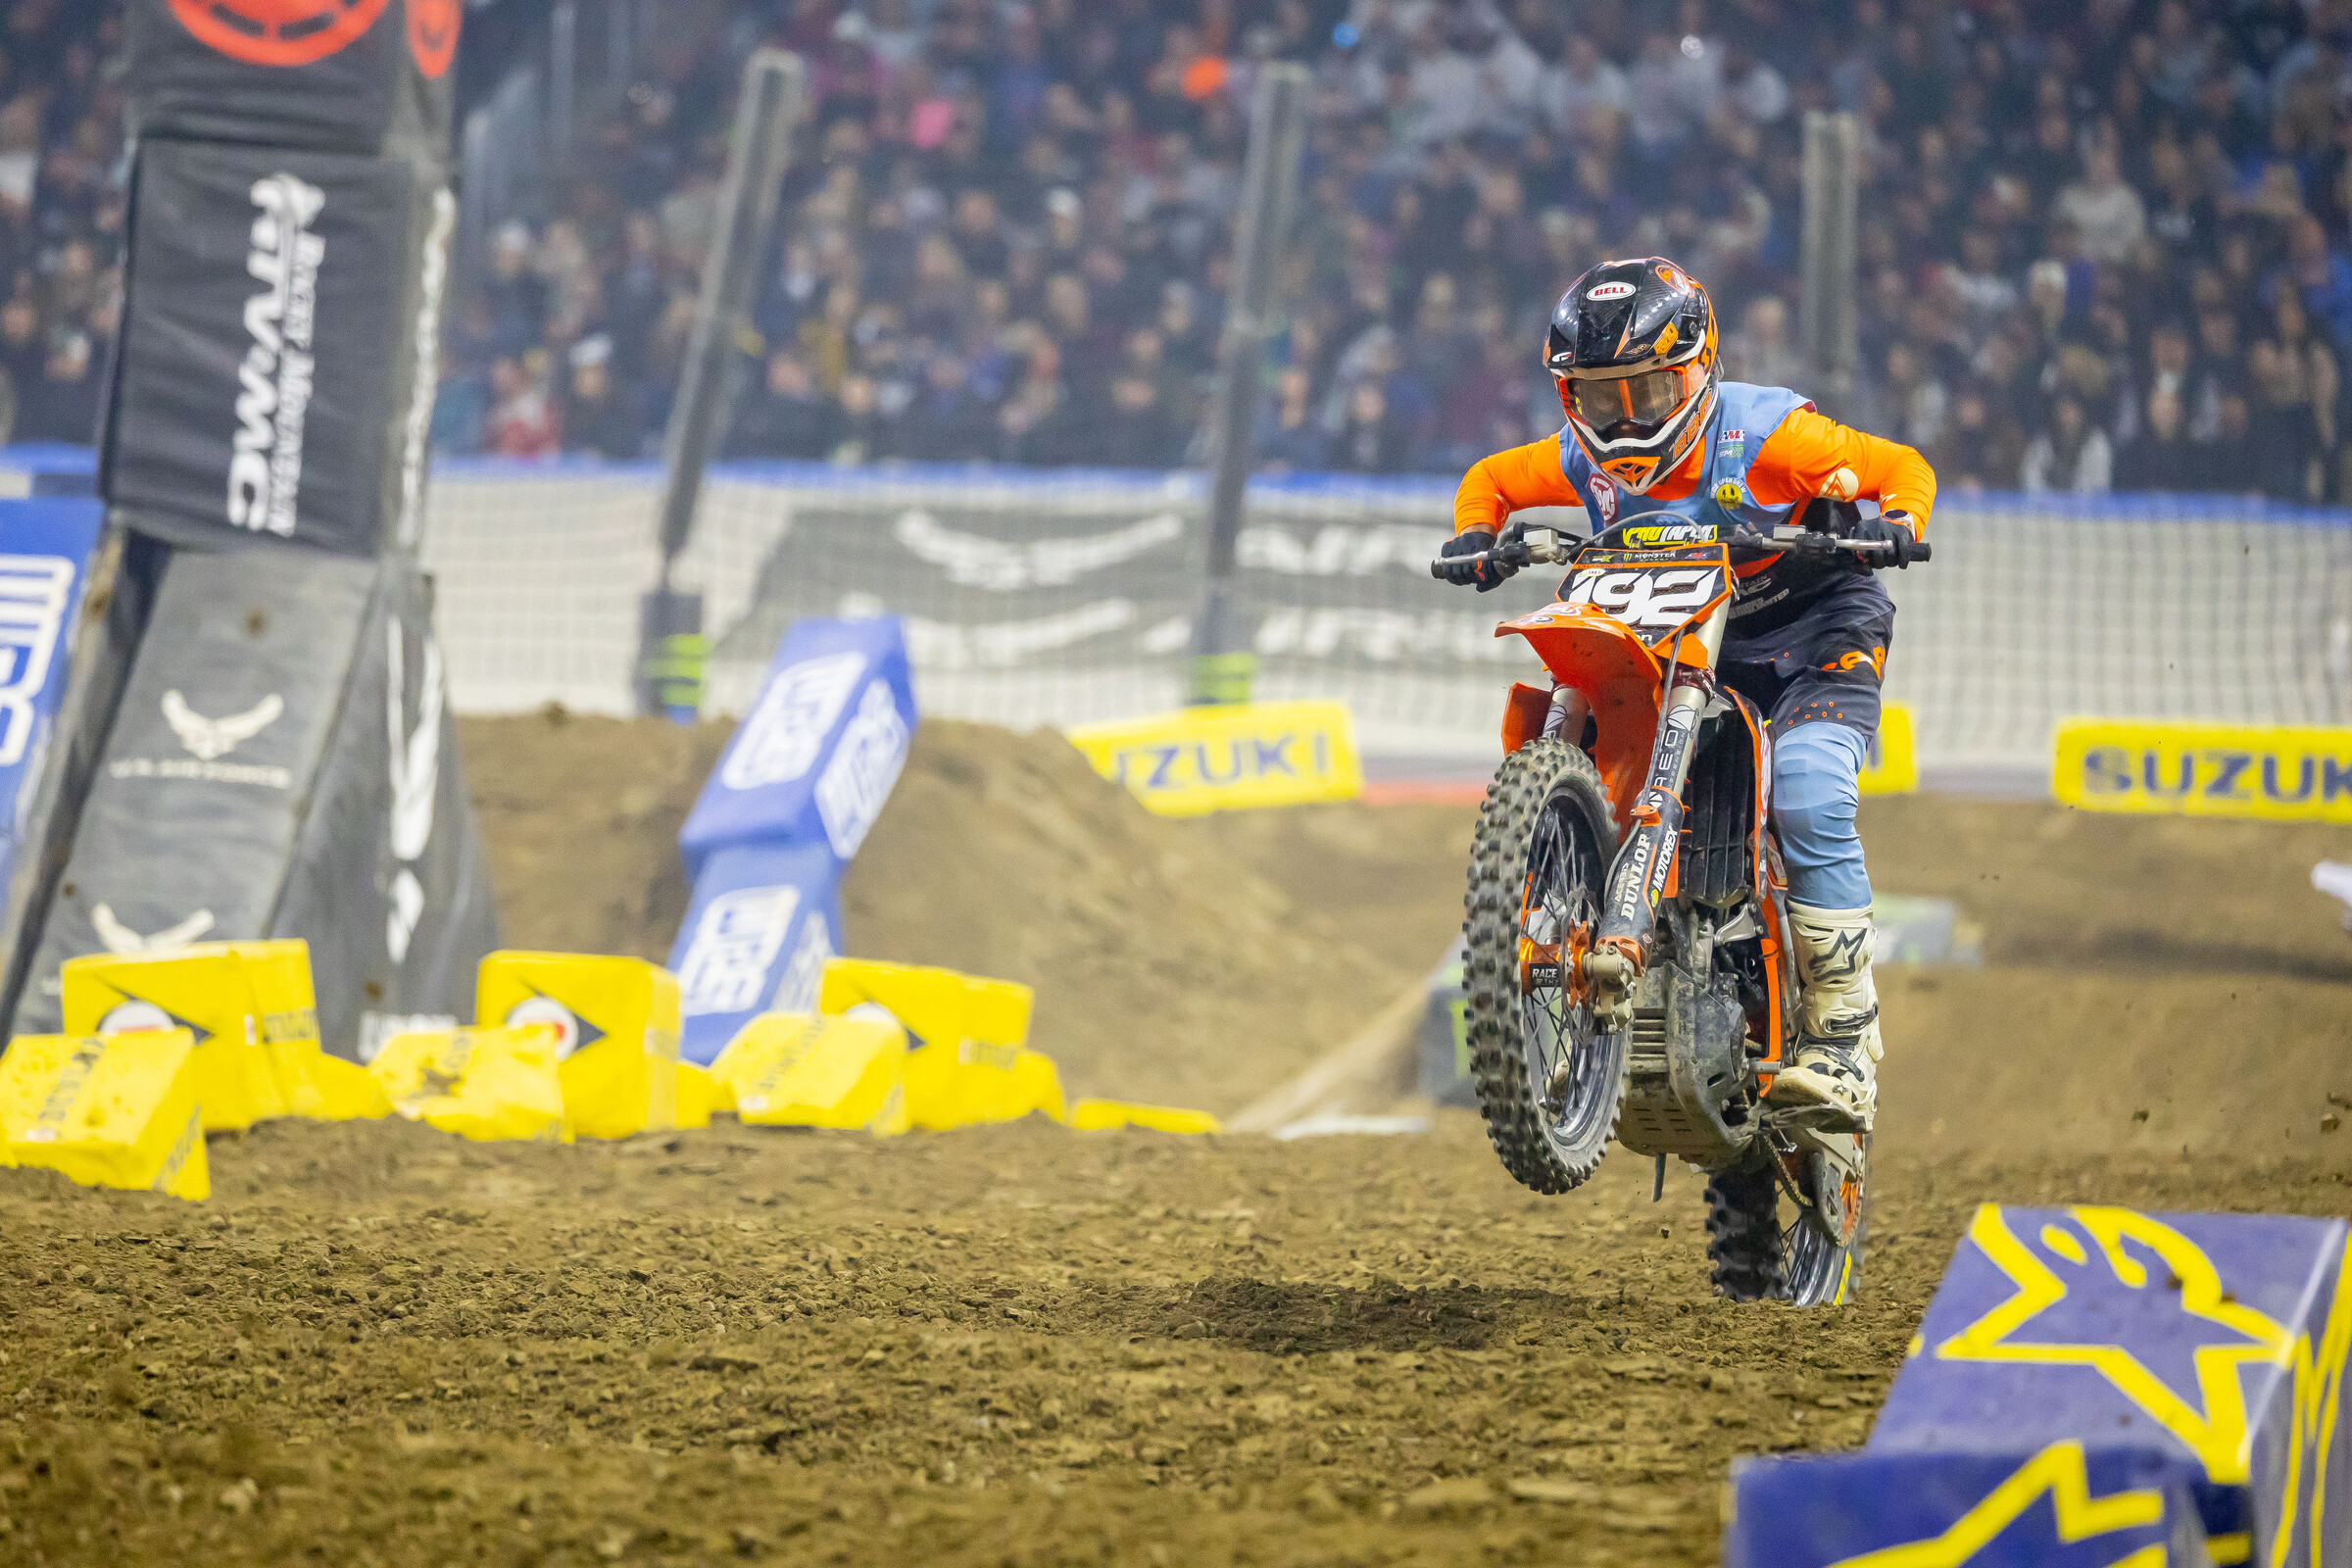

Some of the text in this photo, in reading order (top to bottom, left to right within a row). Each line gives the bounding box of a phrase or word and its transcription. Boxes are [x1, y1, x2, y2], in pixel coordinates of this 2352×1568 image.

[1594, 286, 1628, 297] BELL
[1719, 430, 1745, 443] AMA
[1568, 565, 1722, 627] 192
[1114, 729, 1330, 790] ZUKI
[2083, 746, 2352, 804] SUZUK
[1621, 833, 1651, 921] DUNLOP
[1656, 824, 1679, 893] MOTOREX
[1532, 968, 1558, 978] RACE
